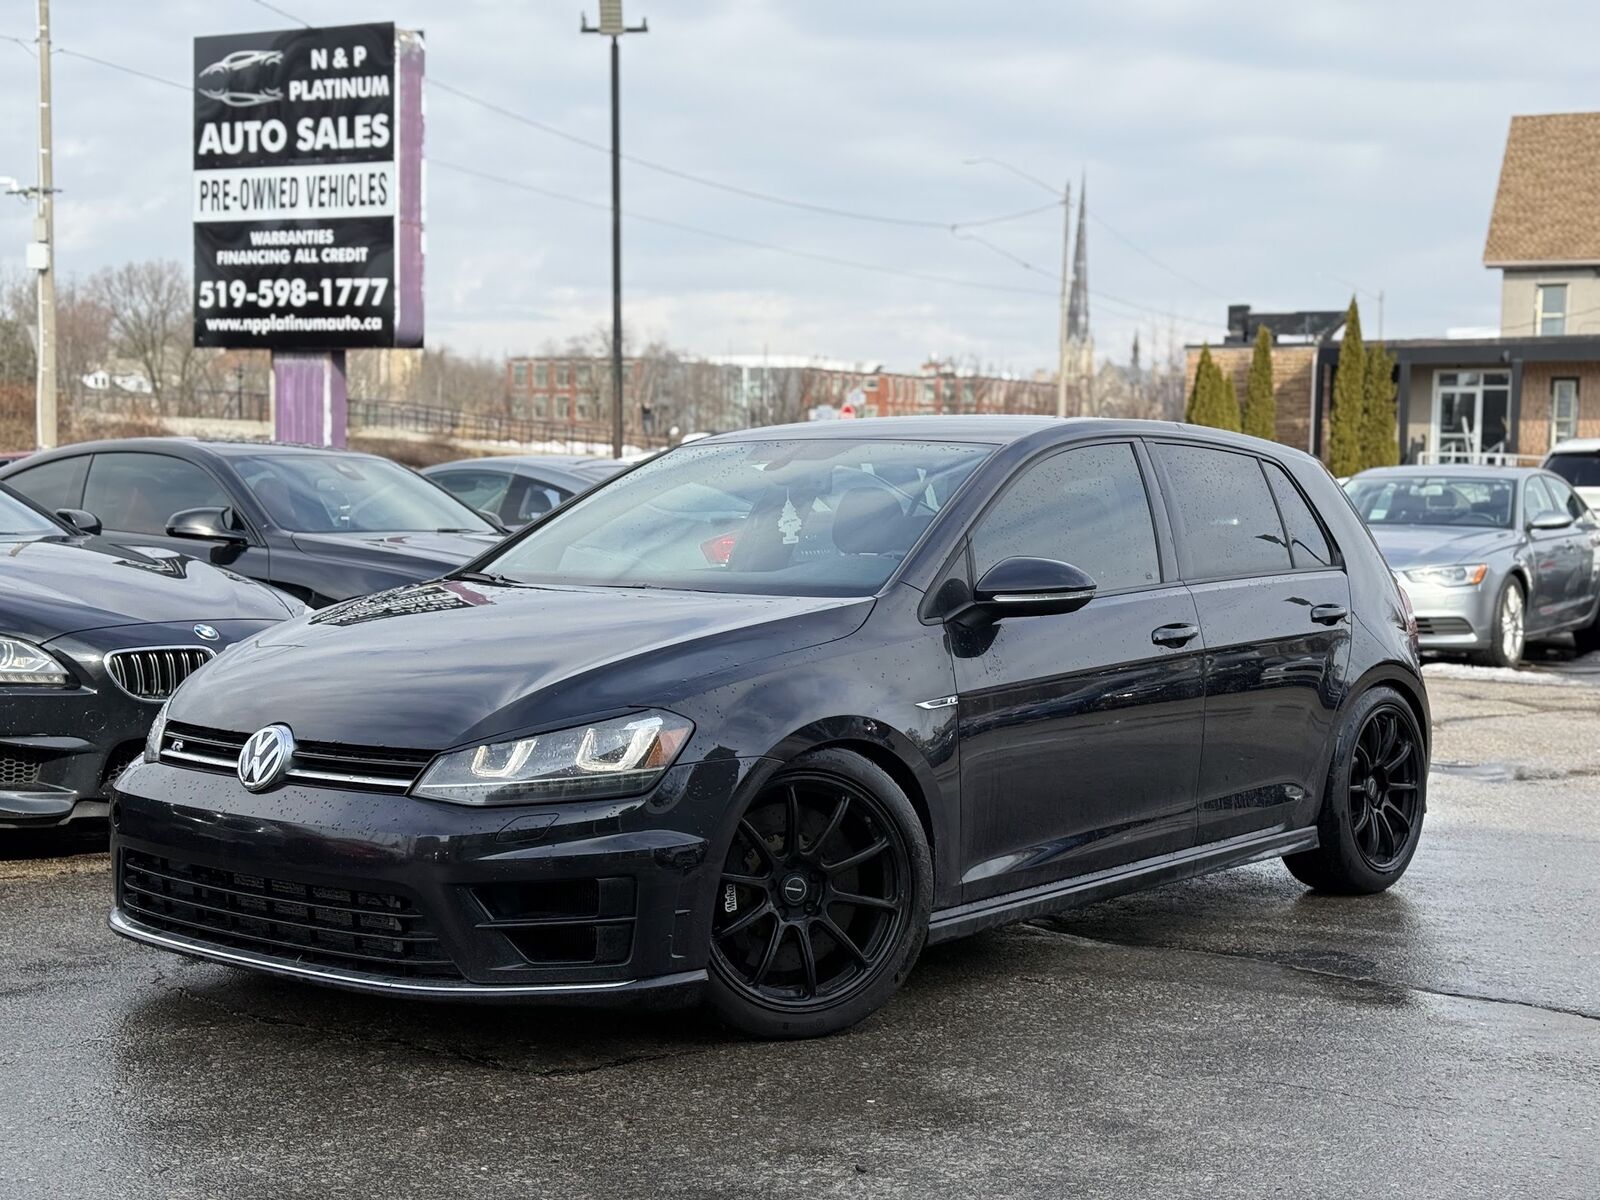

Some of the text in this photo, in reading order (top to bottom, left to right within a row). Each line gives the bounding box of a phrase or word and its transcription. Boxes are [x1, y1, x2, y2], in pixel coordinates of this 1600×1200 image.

[311, 46, 367, 69] N & P
[289, 75, 389, 101] PLATINUM
[198, 113, 389, 154] AUTO SALES
[200, 173, 387, 211] PRE-OWNED VEHICLES
[250, 229, 334, 245] WARRANTIES
[216, 247, 369, 265] FINANCING ALL CREDIT
[199, 277, 388, 307] 519-598-1777
[205, 314, 382, 334] www.npplatinumauto.ca
